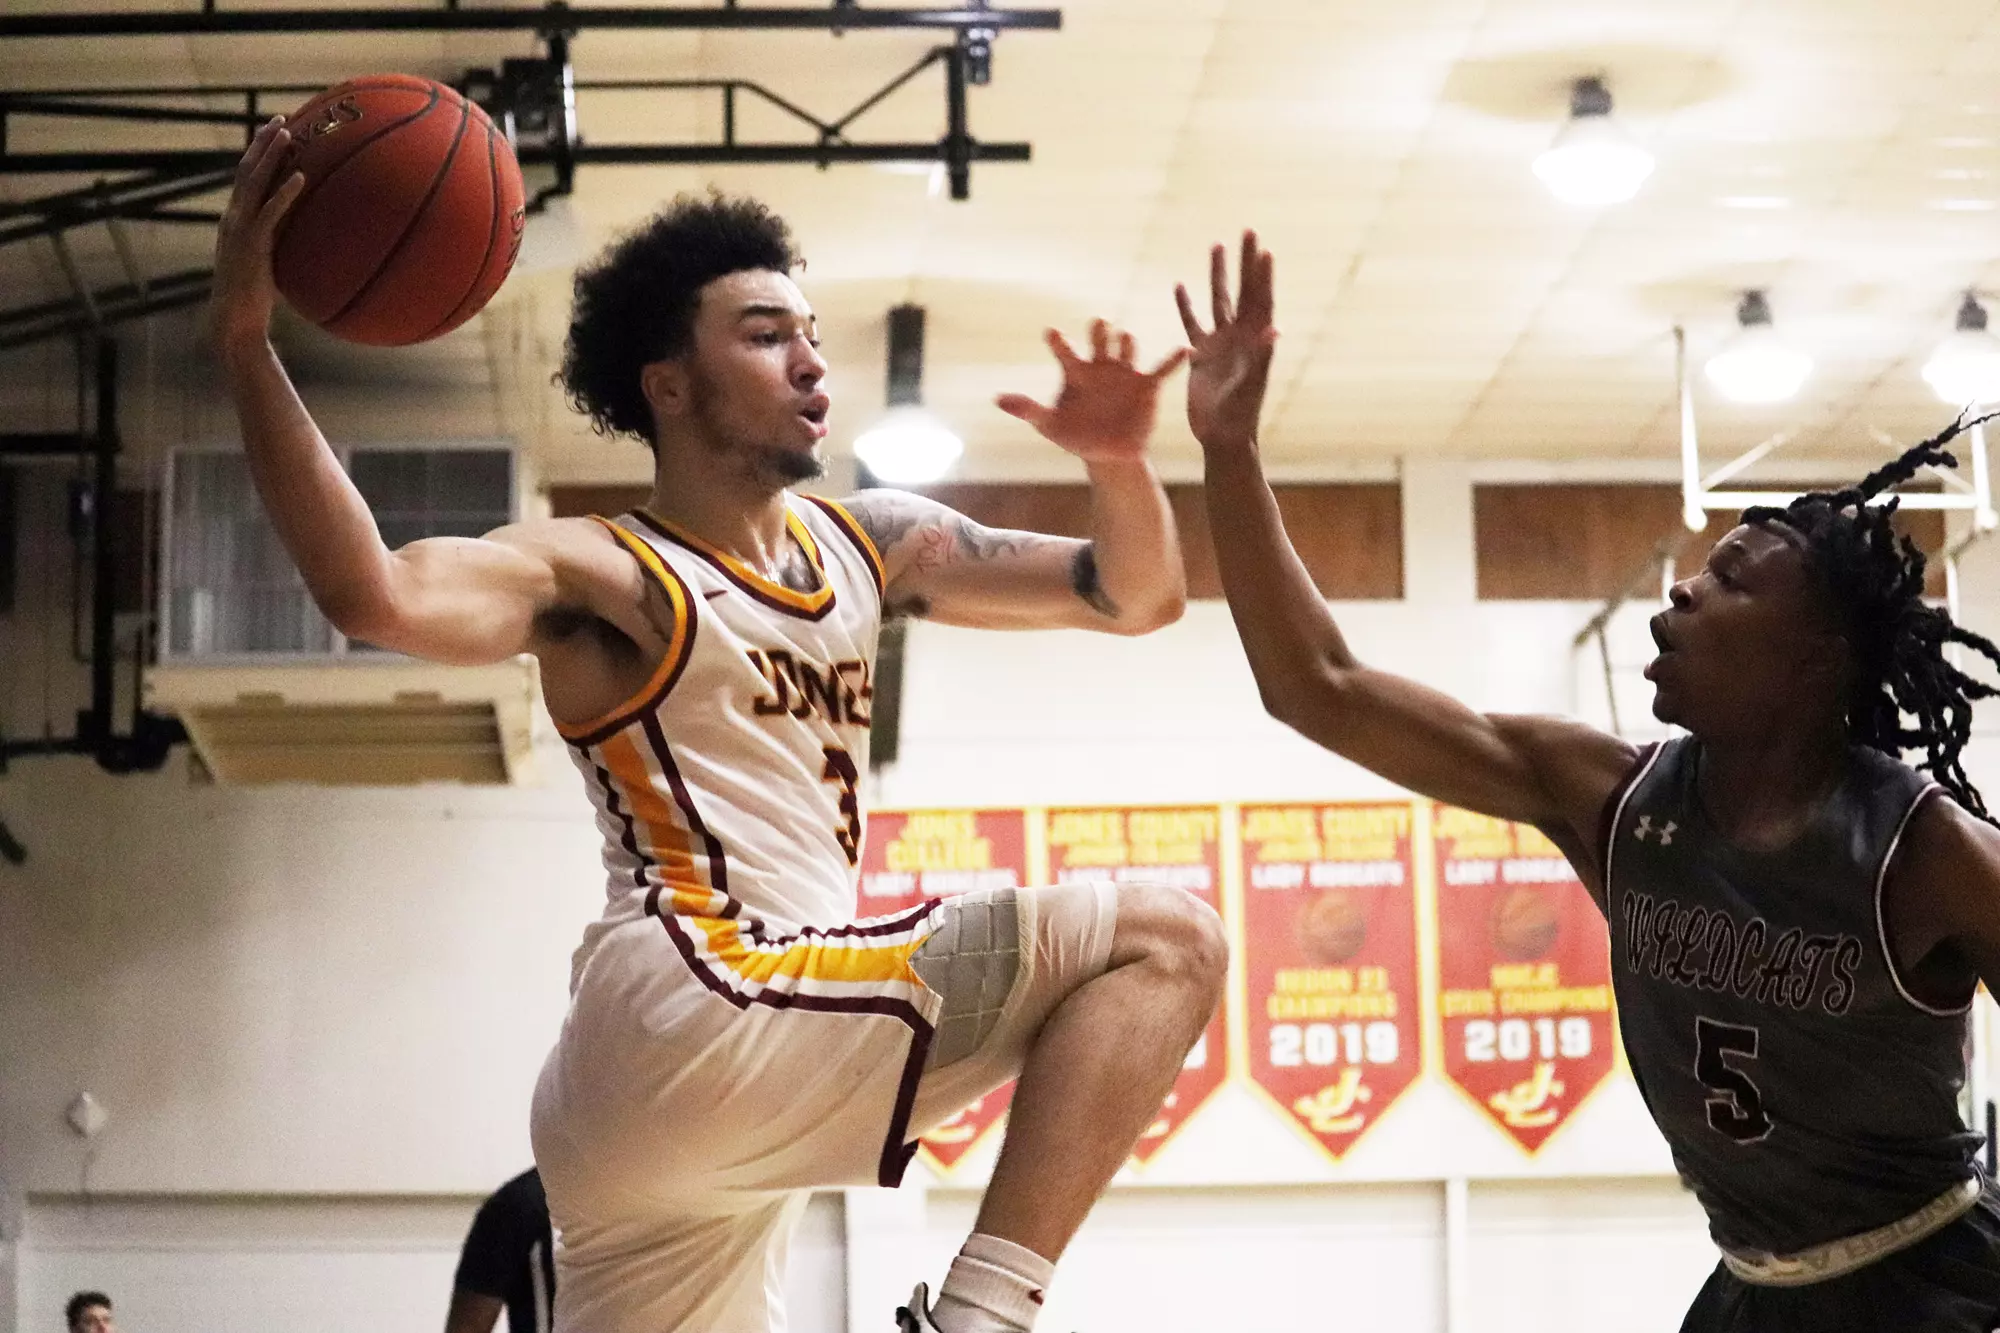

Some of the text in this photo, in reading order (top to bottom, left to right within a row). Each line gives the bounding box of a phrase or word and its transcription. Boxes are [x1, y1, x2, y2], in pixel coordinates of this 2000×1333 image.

[1623, 889, 1863, 1016] WILDCATS
[1269, 1020, 1399, 1067] 2019
[1464, 1016, 1592, 1062] 2019
[1694, 1015, 1776, 1145] 5
